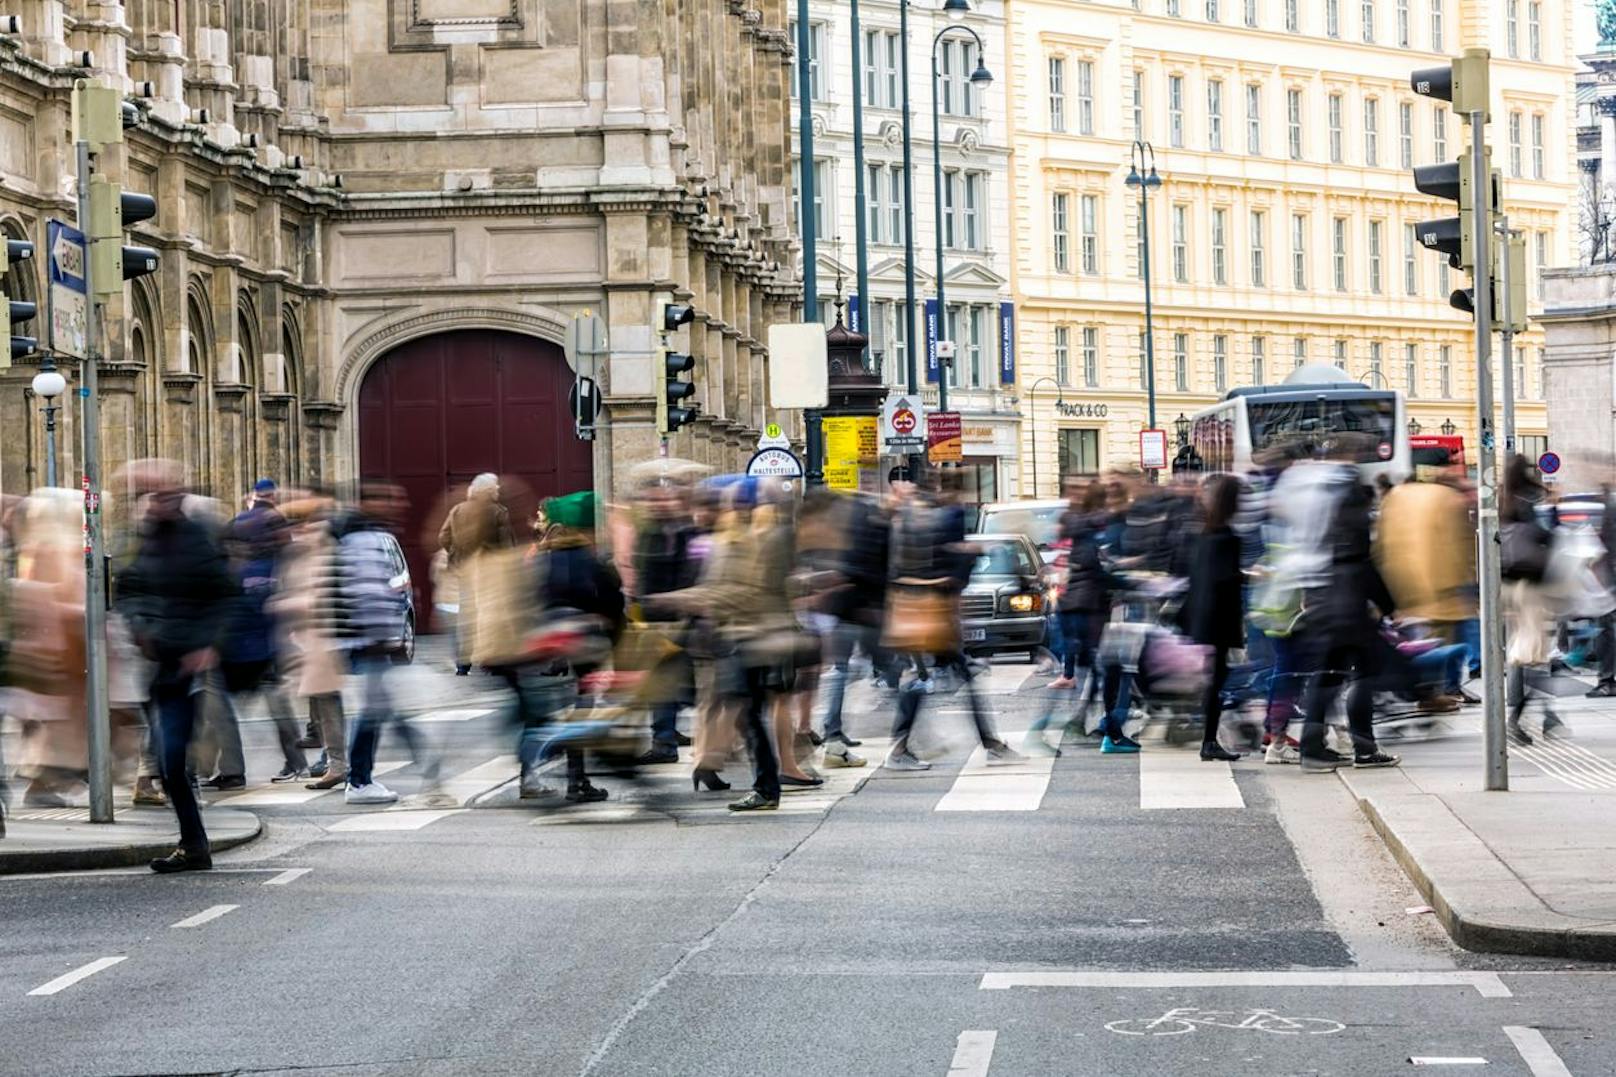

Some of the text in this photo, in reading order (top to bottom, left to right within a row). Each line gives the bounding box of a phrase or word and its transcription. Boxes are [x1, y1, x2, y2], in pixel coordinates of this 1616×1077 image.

[1086, 404, 1093, 417] &
[1094, 404, 1108, 417] CO
[760, 452, 790, 463] AUTOBUS
